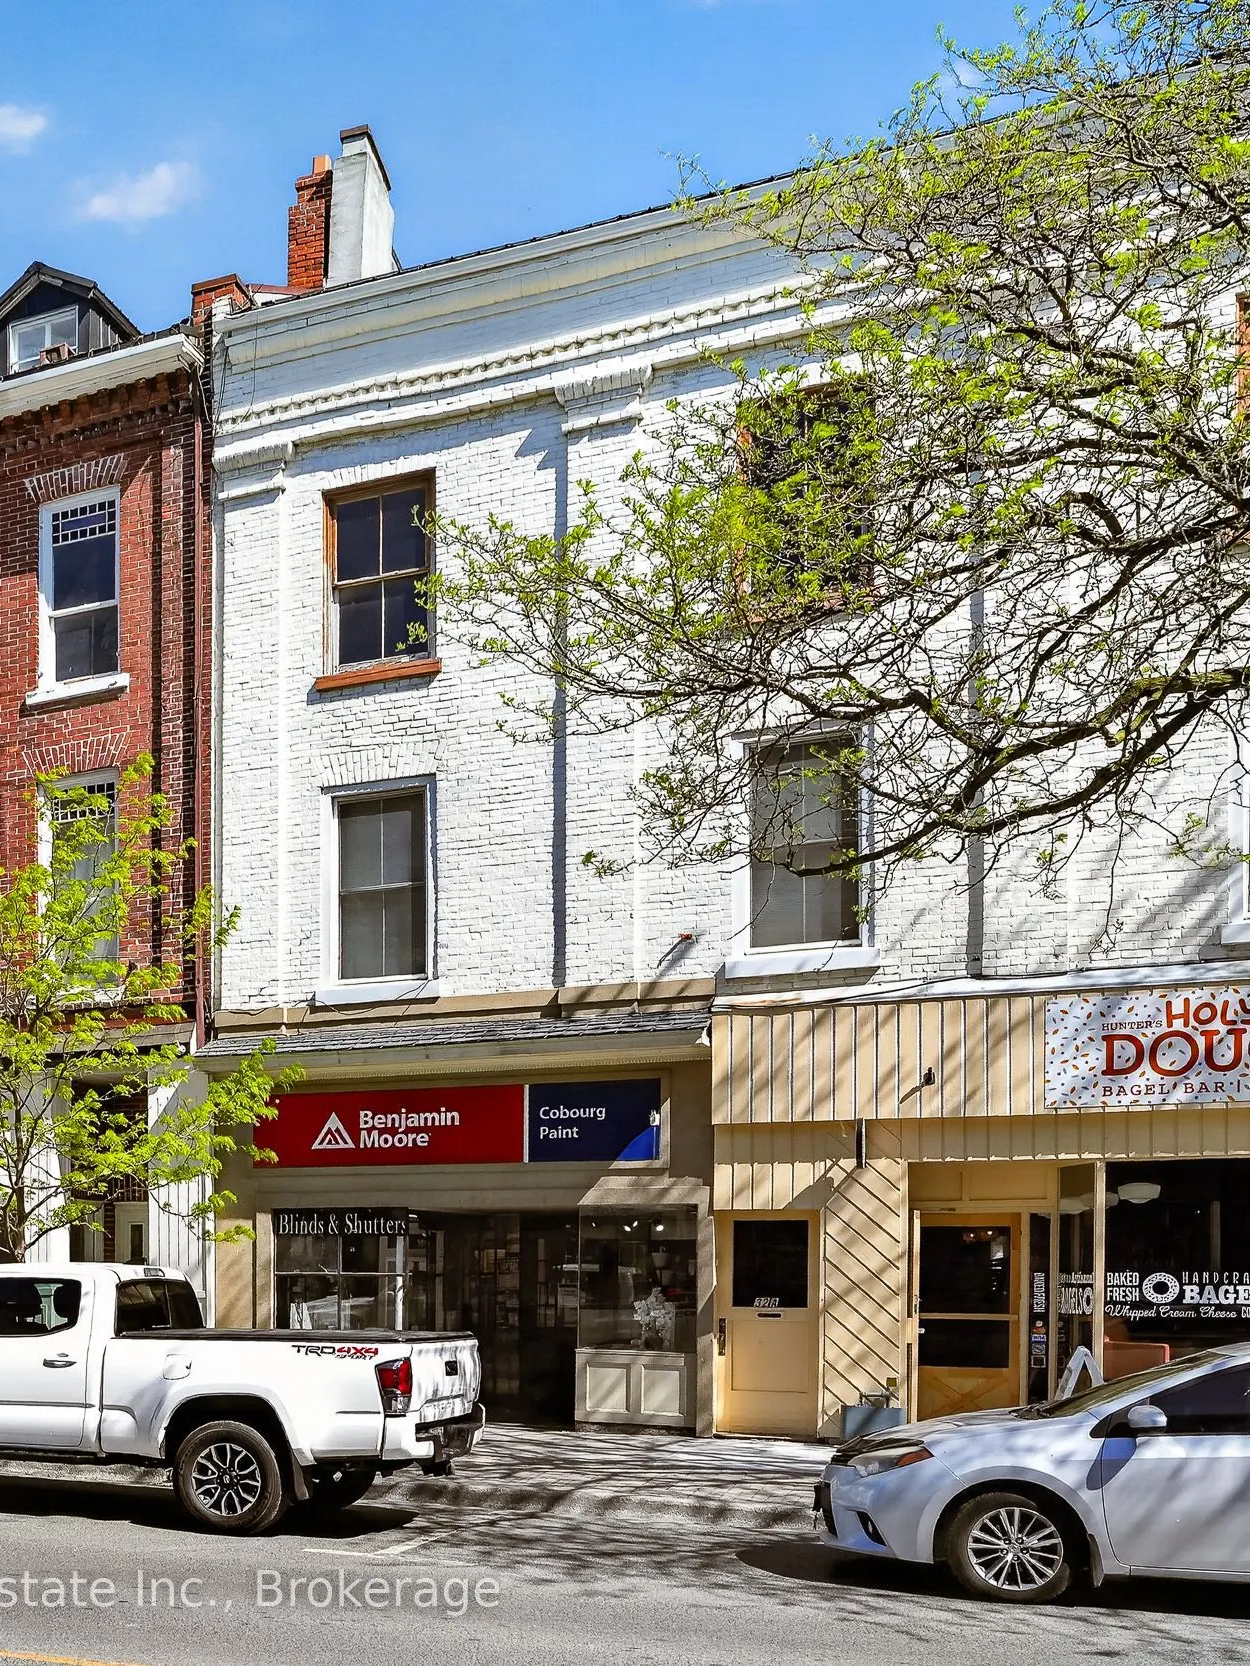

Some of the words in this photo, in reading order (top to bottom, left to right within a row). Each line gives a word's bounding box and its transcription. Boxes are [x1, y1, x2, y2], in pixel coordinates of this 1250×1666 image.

[1102, 1020, 1163, 1031] HUNTER'S
[1101, 1028, 1250, 1077] DOU
[1102, 1083, 1170, 1097] BAGEL
[1183, 1081, 1226, 1094] BAR
[359, 1107, 460, 1132] Benjamin
[539, 1105, 606, 1121] Cobourg
[359, 1130, 430, 1148] Moore
[539, 1126, 579, 1139] Paint
[279, 1213, 324, 1235] Blinds
[328, 1213, 338, 1235] &
[344, 1213, 406, 1235] Shutters
[1106, 1272, 1139, 1286] BAKED
[1182, 1271, 1250, 1284] HANDCRA
[1106, 1287, 1139, 1301] FRESH
[1182, 1285, 1250, 1304] BAGE
[1200, 1306, 1237, 1318] Cheese
[291, 1345, 336, 1357] TRD
